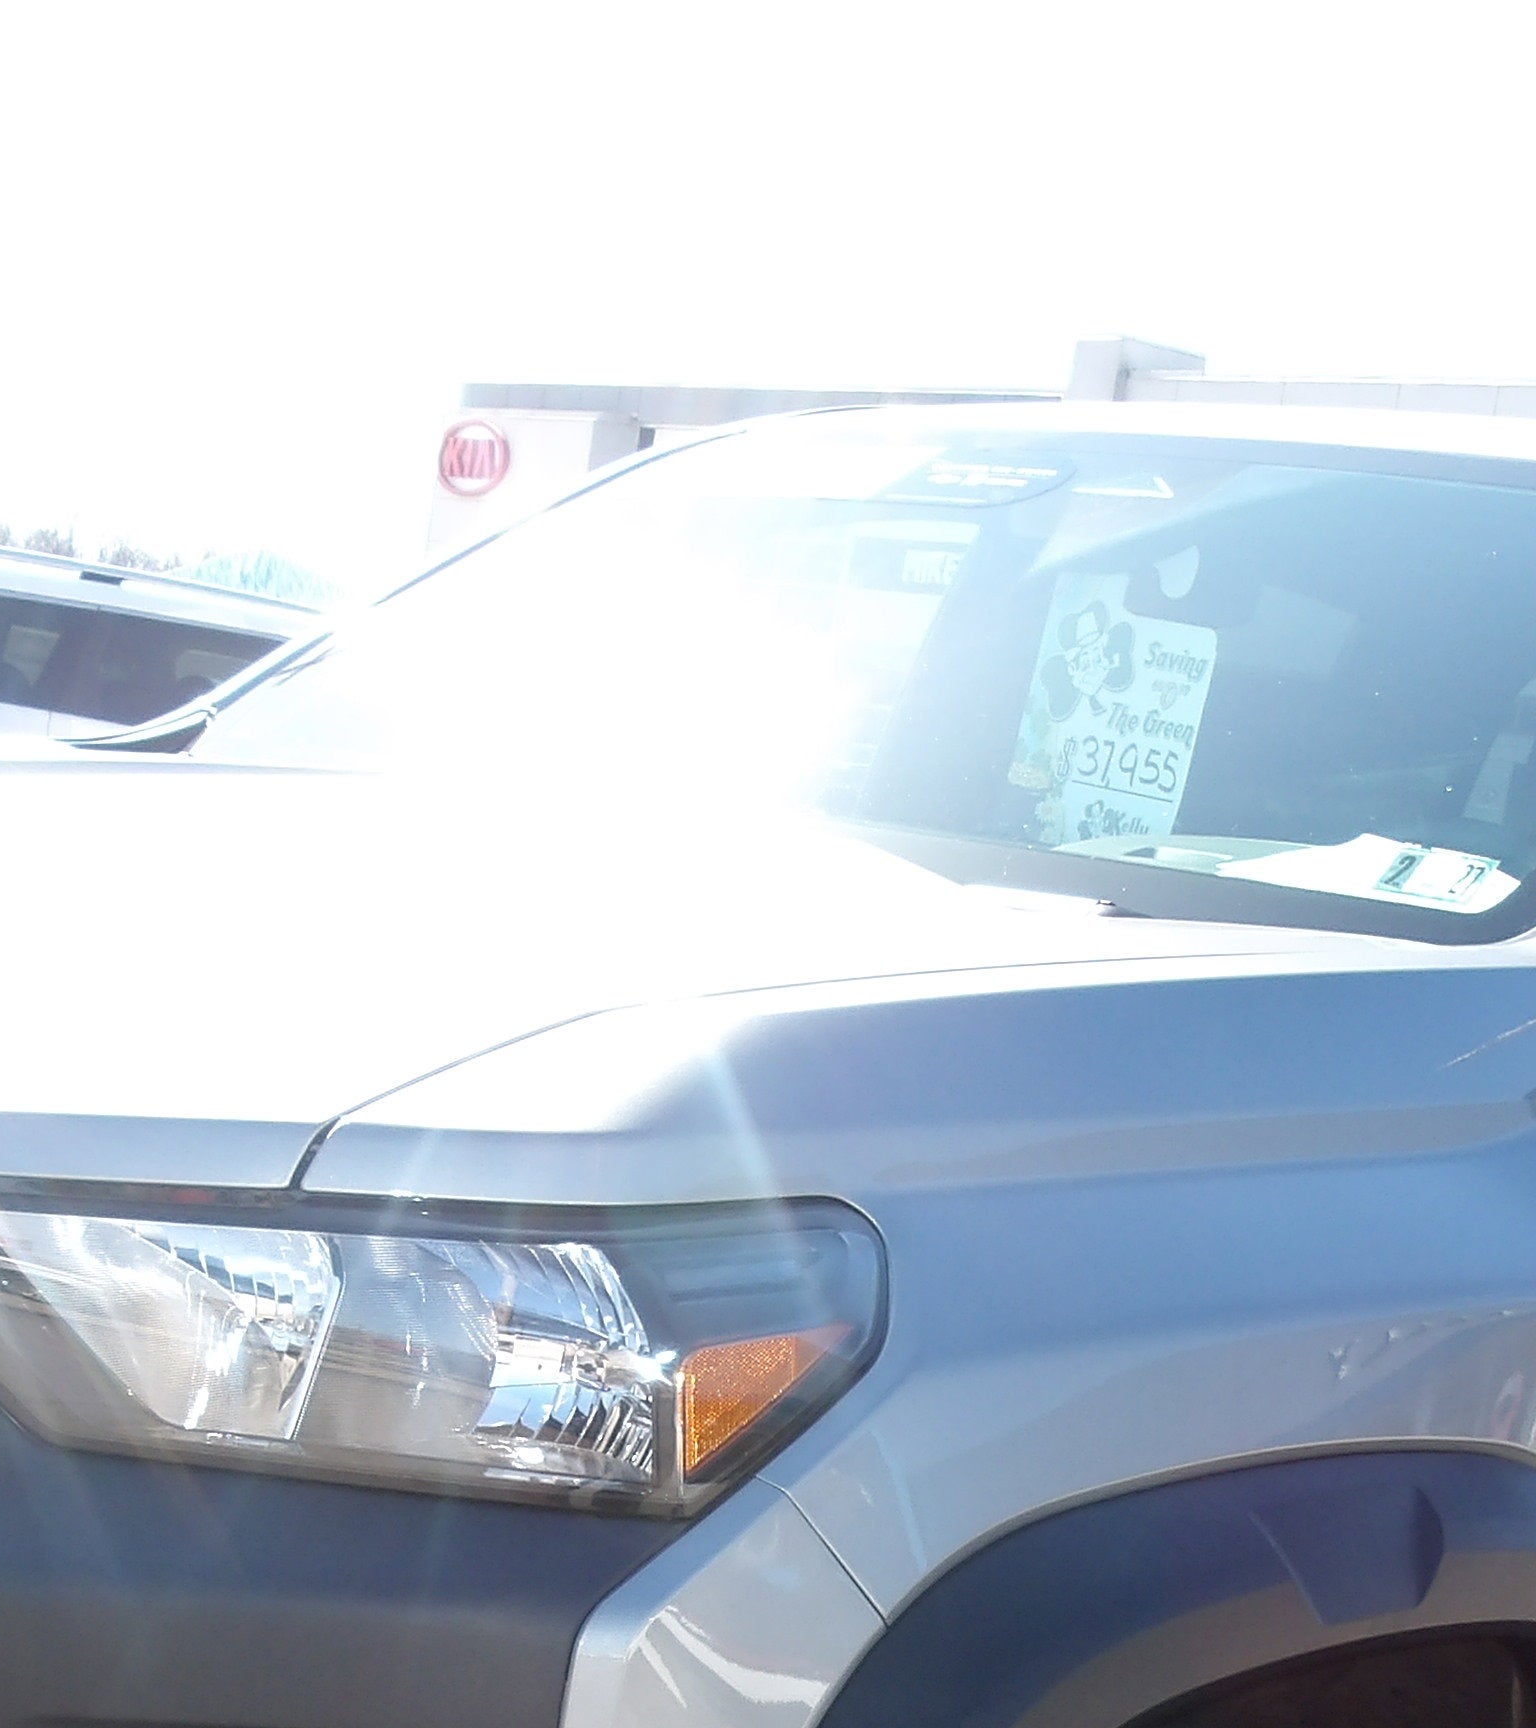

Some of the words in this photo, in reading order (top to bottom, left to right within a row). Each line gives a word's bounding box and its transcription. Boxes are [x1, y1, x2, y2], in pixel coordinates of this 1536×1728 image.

[443, 436, 496, 479] KIA
[1145, 641, 1207, 682] Saving
[1107, 703, 1139, 737] The
[1143, 709, 1194, 751] Green
[1383, 855, 1417, 887] 2
